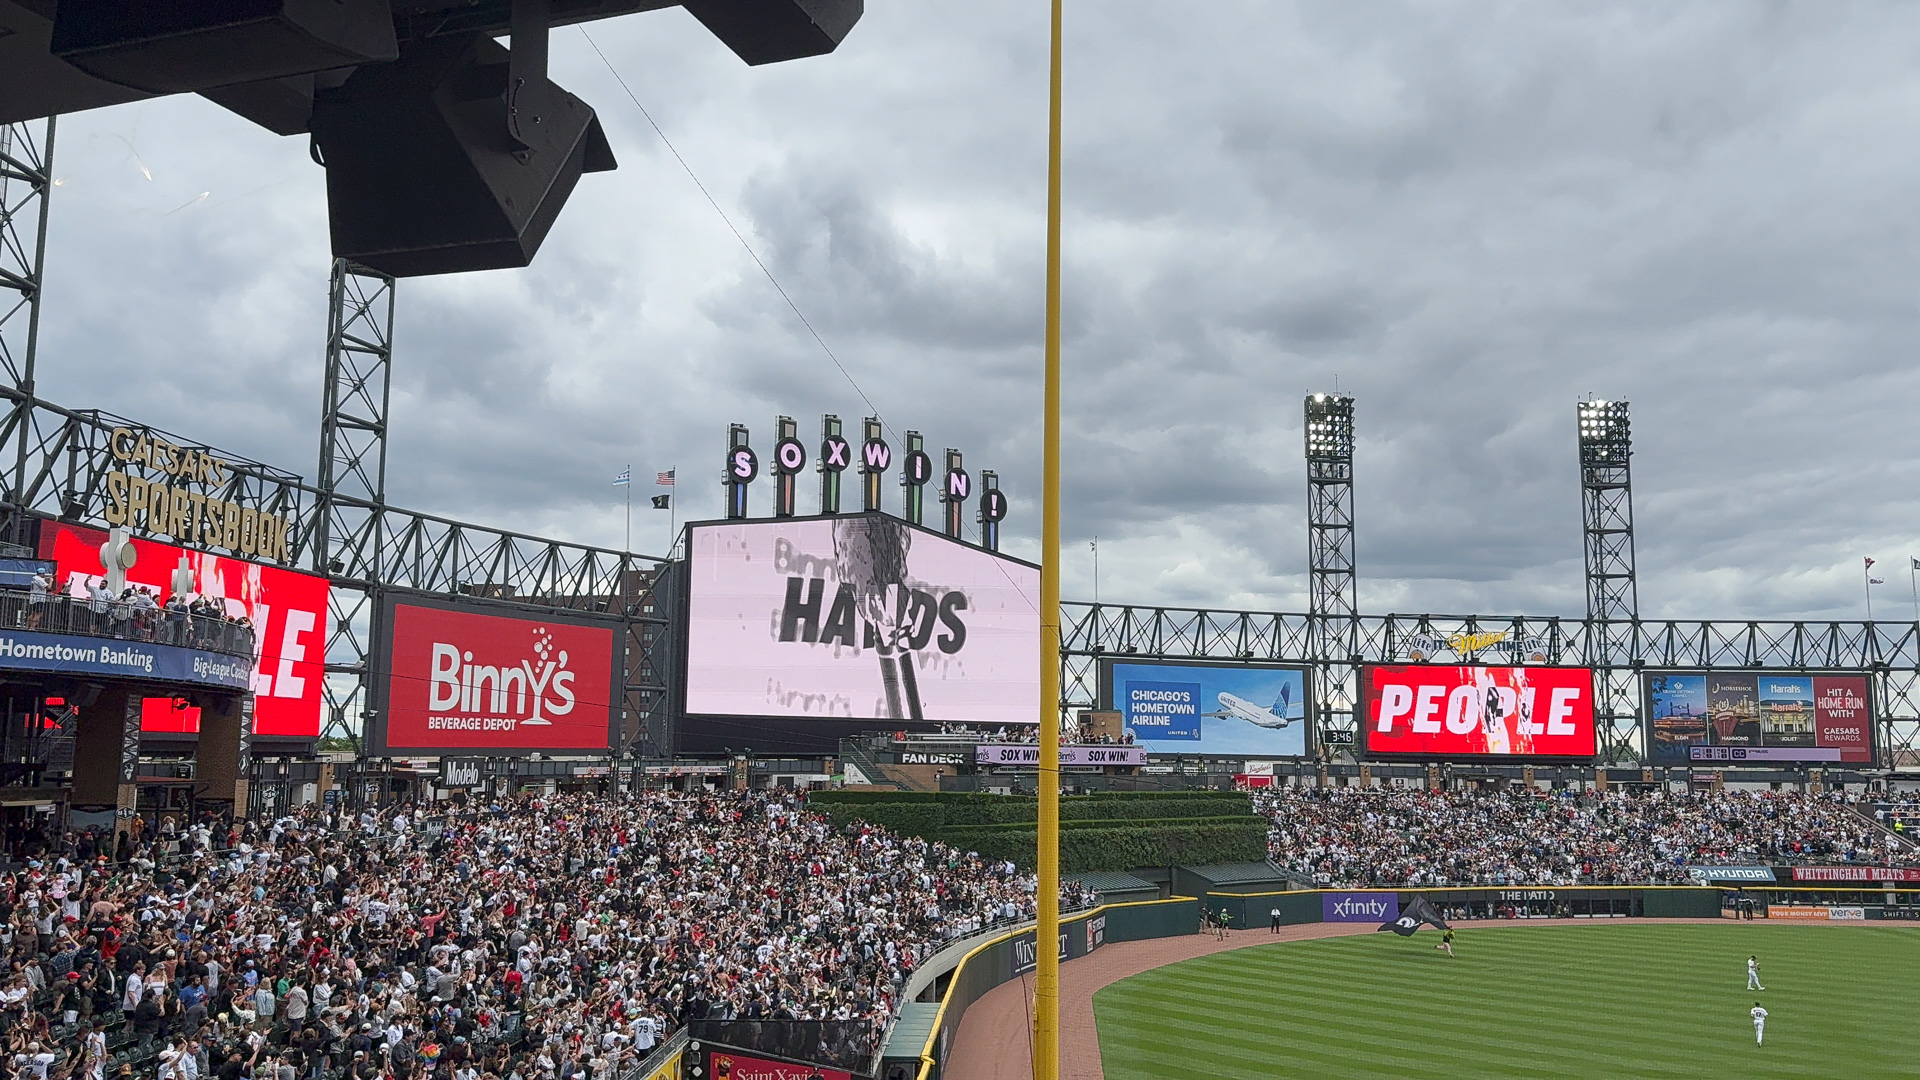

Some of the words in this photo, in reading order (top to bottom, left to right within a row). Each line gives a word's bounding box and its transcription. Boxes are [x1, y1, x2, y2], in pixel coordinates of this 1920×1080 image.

[111, 427, 227, 488] CAESARS
[105, 471, 291, 562] SPORTSBOOK
[778, 577, 968, 655] HANDS
[1447, 631, 1508, 656] Miller
[1497, 641, 1523, 652] TIME
[0, 638, 96, 662] Hometown
[100, 646, 153, 673] Banking
[193, 656, 231, 680] Big-League
[428, 641, 575, 725] Binny's
[1770, 684, 1801, 694] Harrah's
[1131, 689, 1191, 702] CHICAGO'S
[1827, 688, 1843, 697] HIT
[1846, 688, 1853, 697] A
[1131, 702, 1195, 715] HOMETOWN
[1377, 684, 1581, 736] PEOPLE
[1818, 697, 1843, 710] HOME
[1845, 697, 1864, 710] RUN
[1828, 709, 1855, 718] WITH
[428, 717, 481, 730] BEVERAGE
[483, 718, 516, 731] DEPOT
[1131, 715, 1171, 726] AIRLINE
[1332, 731, 1352, 742] 3:46
[1823, 727, 1860, 735] CAESARS
[902, 753, 927, 764] FAN
[930, 753, 964, 764] DECK
[1000, 749, 1020, 761] SOX
[1088, 750, 1106, 762] SOX
[1108, 751, 1129, 762] WIN!
[1734, 750, 1745, 758] CC
[446, 761, 479, 785] Modelo
[1708, 869, 1769, 878] HYUNDAI
[1795, 867, 1868, 880] WHITTINGHAM
[1872, 868, 1904, 880] MEATS
[1500, 891, 1521, 900] THE
[1333, 897, 1388, 918] xfinity
[638, 1025, 649, 1034] 79
[736, 1068, 774, 1080] Saint
